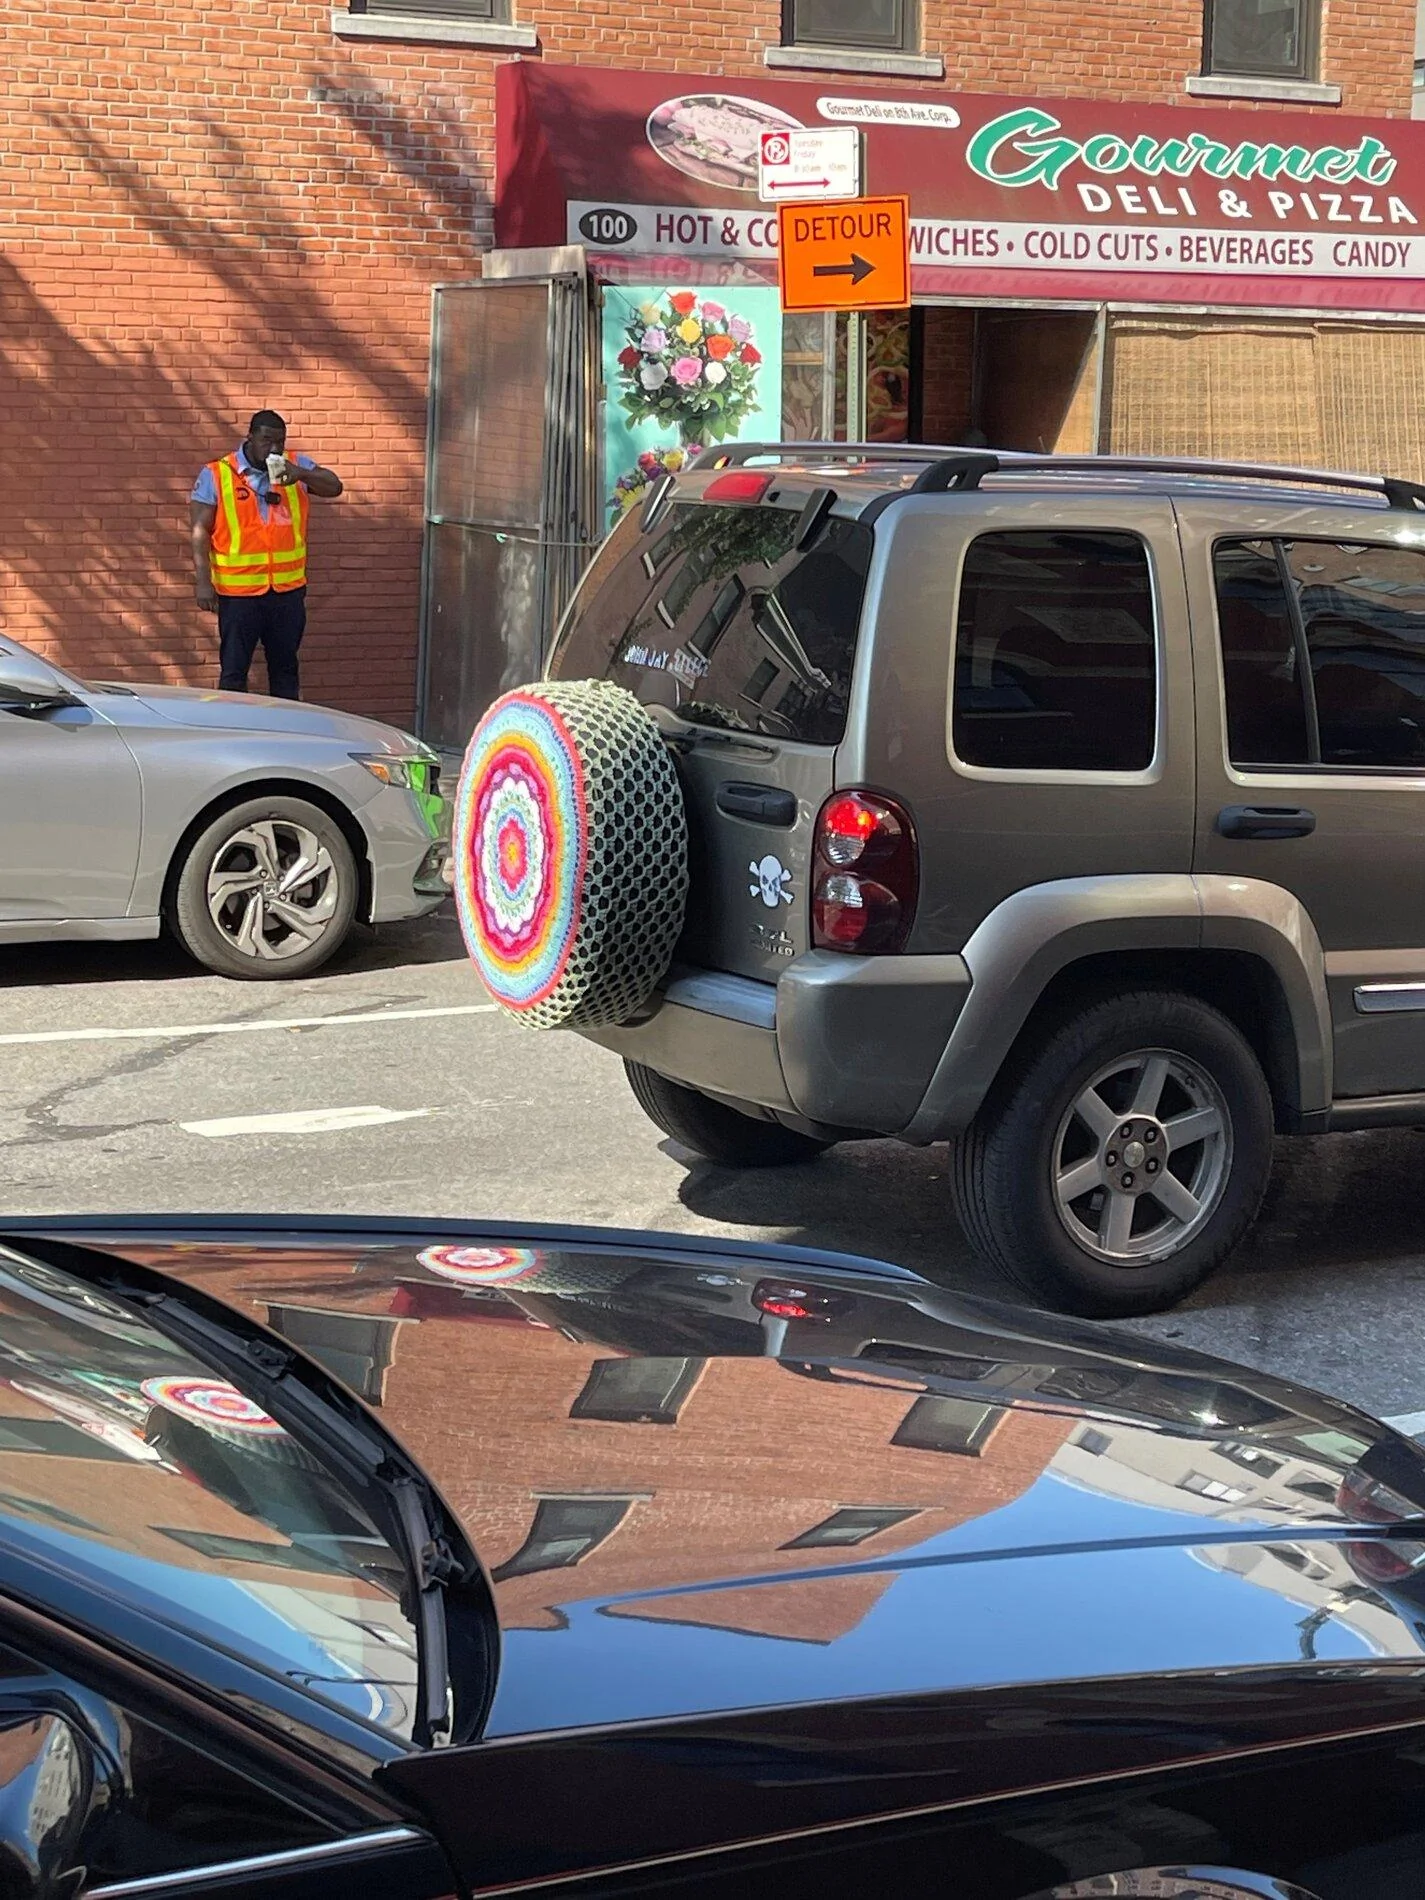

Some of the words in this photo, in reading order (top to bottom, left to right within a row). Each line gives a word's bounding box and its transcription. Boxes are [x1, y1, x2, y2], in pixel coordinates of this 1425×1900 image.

[826, 102, 864, 116] Gourmet
[864, 104, 883, 118] Deli
[929, 109, 952, 124] Corp.
[965, 106, 1397, 191] Gourmet
[1077, 183, 1197, 216] DELI
[1218, 189, 1252, 218] &
[1267, 191, 1418, 224] PIZZA
[588, 214, 628, 239] 100
[656, 213, 713, 244] HOT
[720, 216, 740, 246] &
[794, 212, 892, 242] DETOUR
[1024, 230, 1091, 260] COLD
[1098, 232, 1159, 262] CUTS
[1179, 235, 1314, 266] BEVERAGES
[1333, 240, 1412, 268] CANDY
